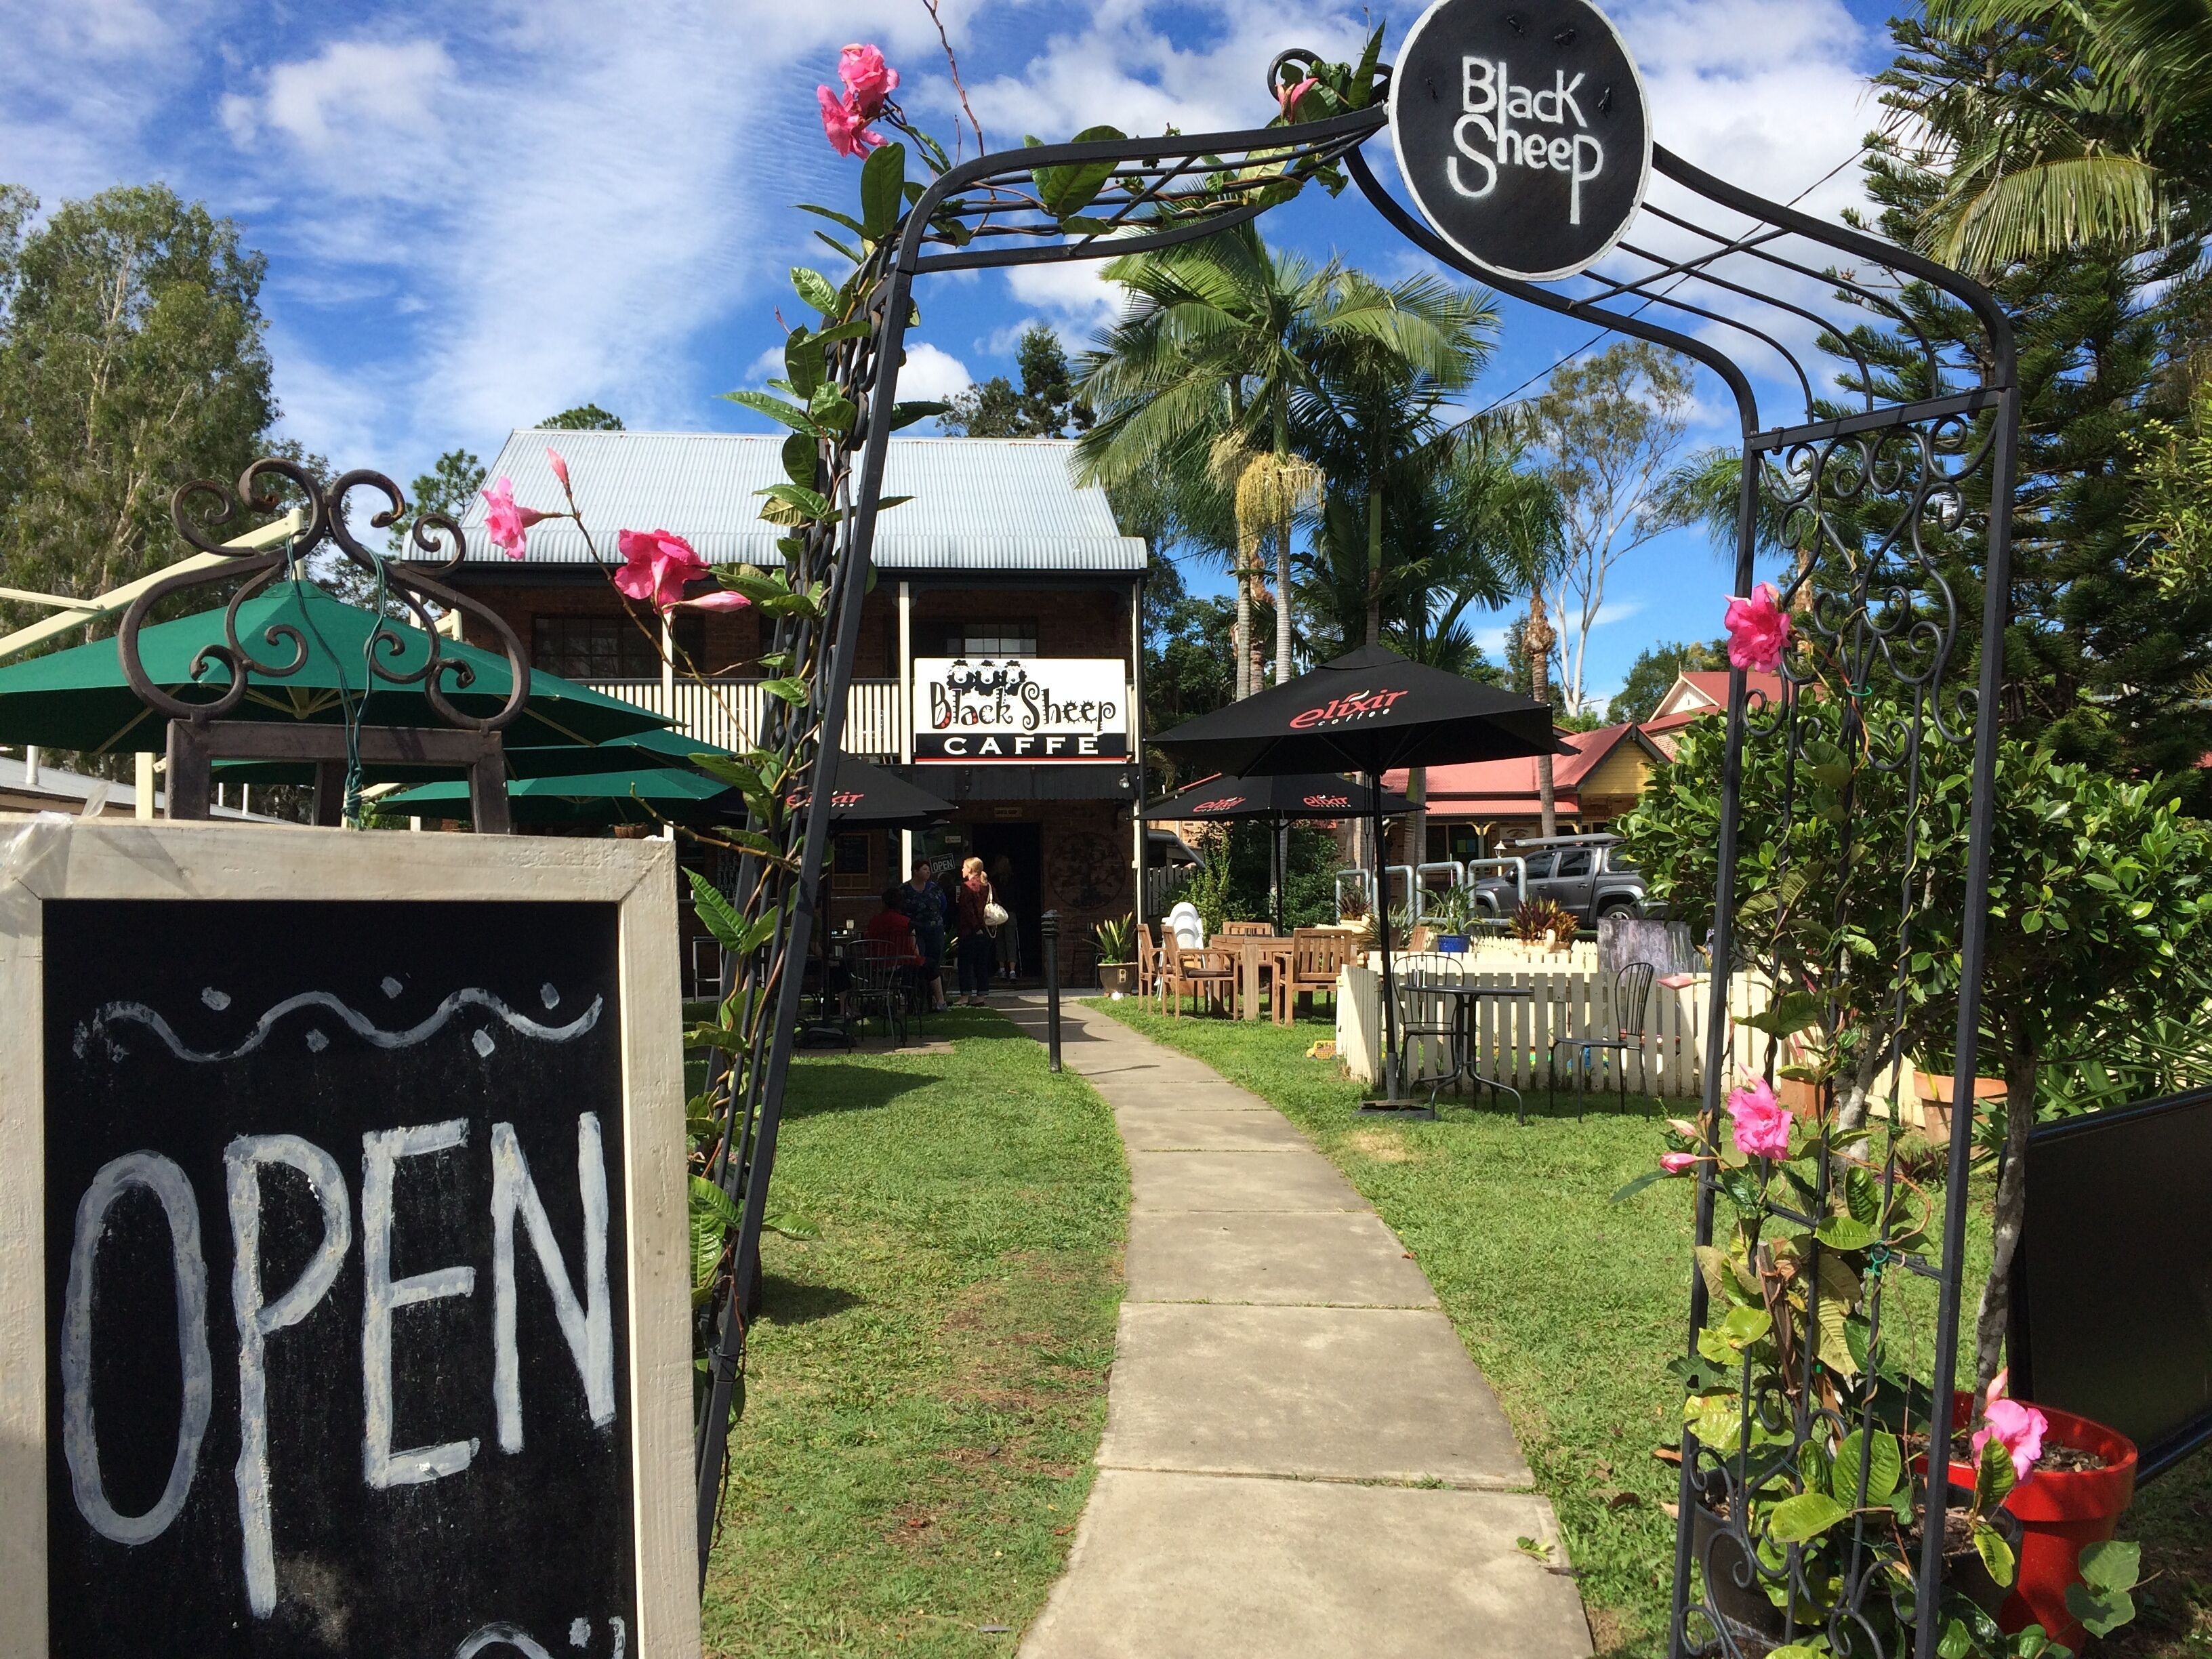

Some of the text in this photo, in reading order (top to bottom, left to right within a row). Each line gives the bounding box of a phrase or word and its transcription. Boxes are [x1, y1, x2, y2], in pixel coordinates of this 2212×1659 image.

[1462, 56, 1588, 127] Black
[1447, 114, 1603, 224] Sheep
[930, 681, 1116, 732] Black Sheep
[1289, 689, 1409, 729] elixir
[1317, 708, 1390, 726] coffee
[943, 737, 1099, 755] CAFFE
[933, 859, 954, 872] OPEN
[61, 1111, 617, 1619] OPEN
